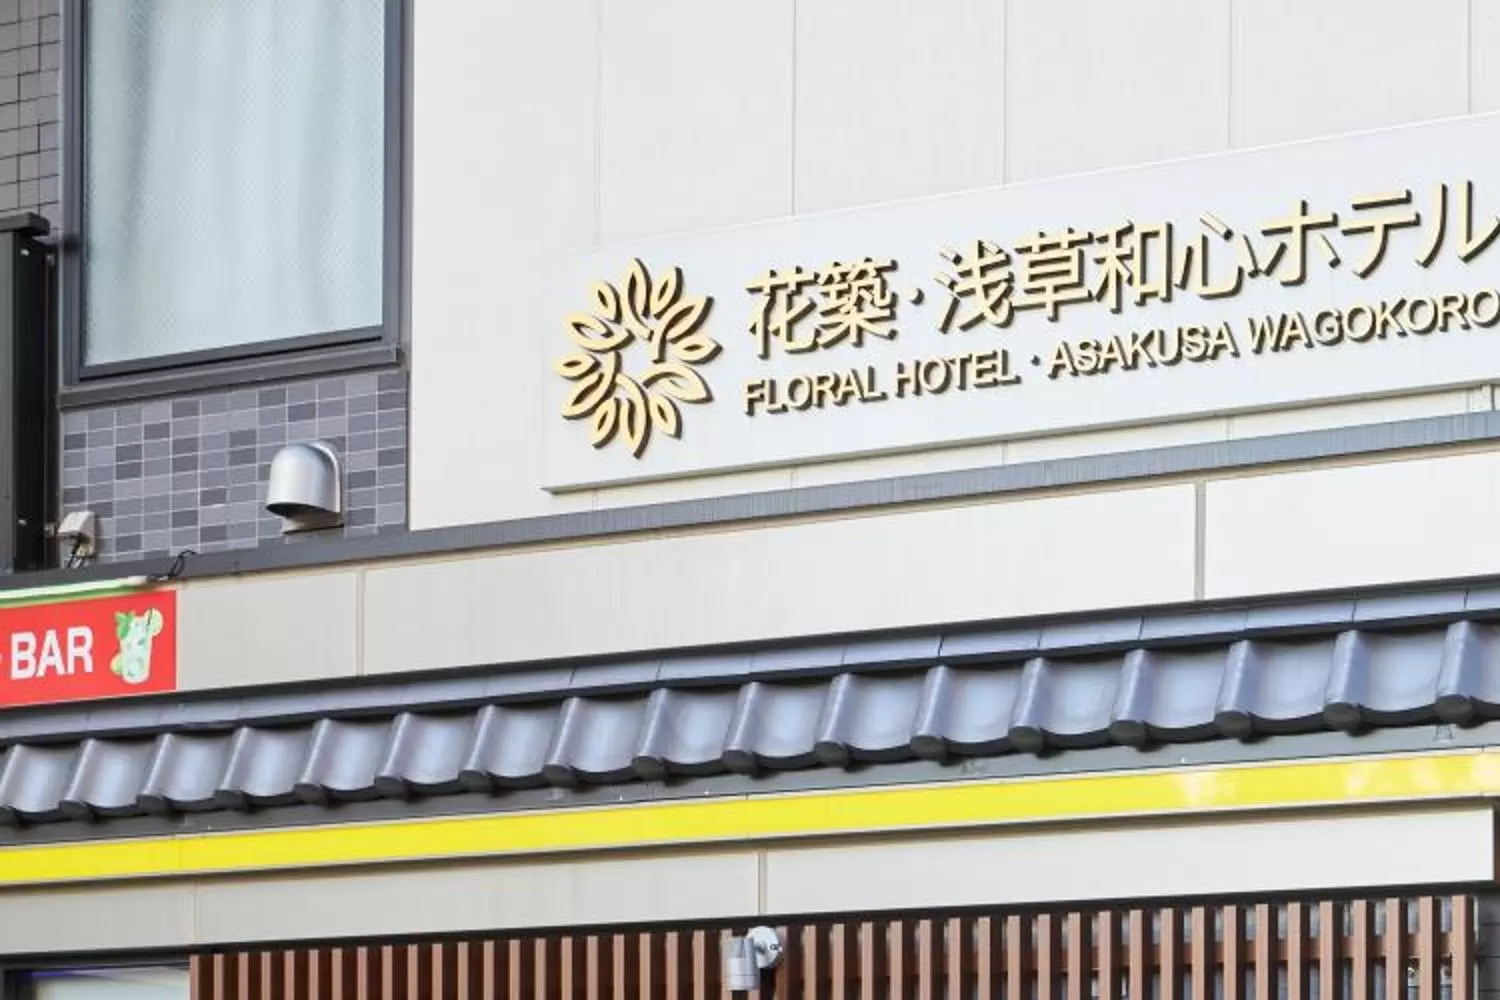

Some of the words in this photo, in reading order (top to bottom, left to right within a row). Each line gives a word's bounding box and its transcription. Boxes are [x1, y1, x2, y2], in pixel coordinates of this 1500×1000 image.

[744, 364, 889, 417] FLORAL
[895, 348, 1022, 399] HOTEL
[1048, 318, 1241, 380] ASAKUSA
[11, 626, 94, 681] BAR
